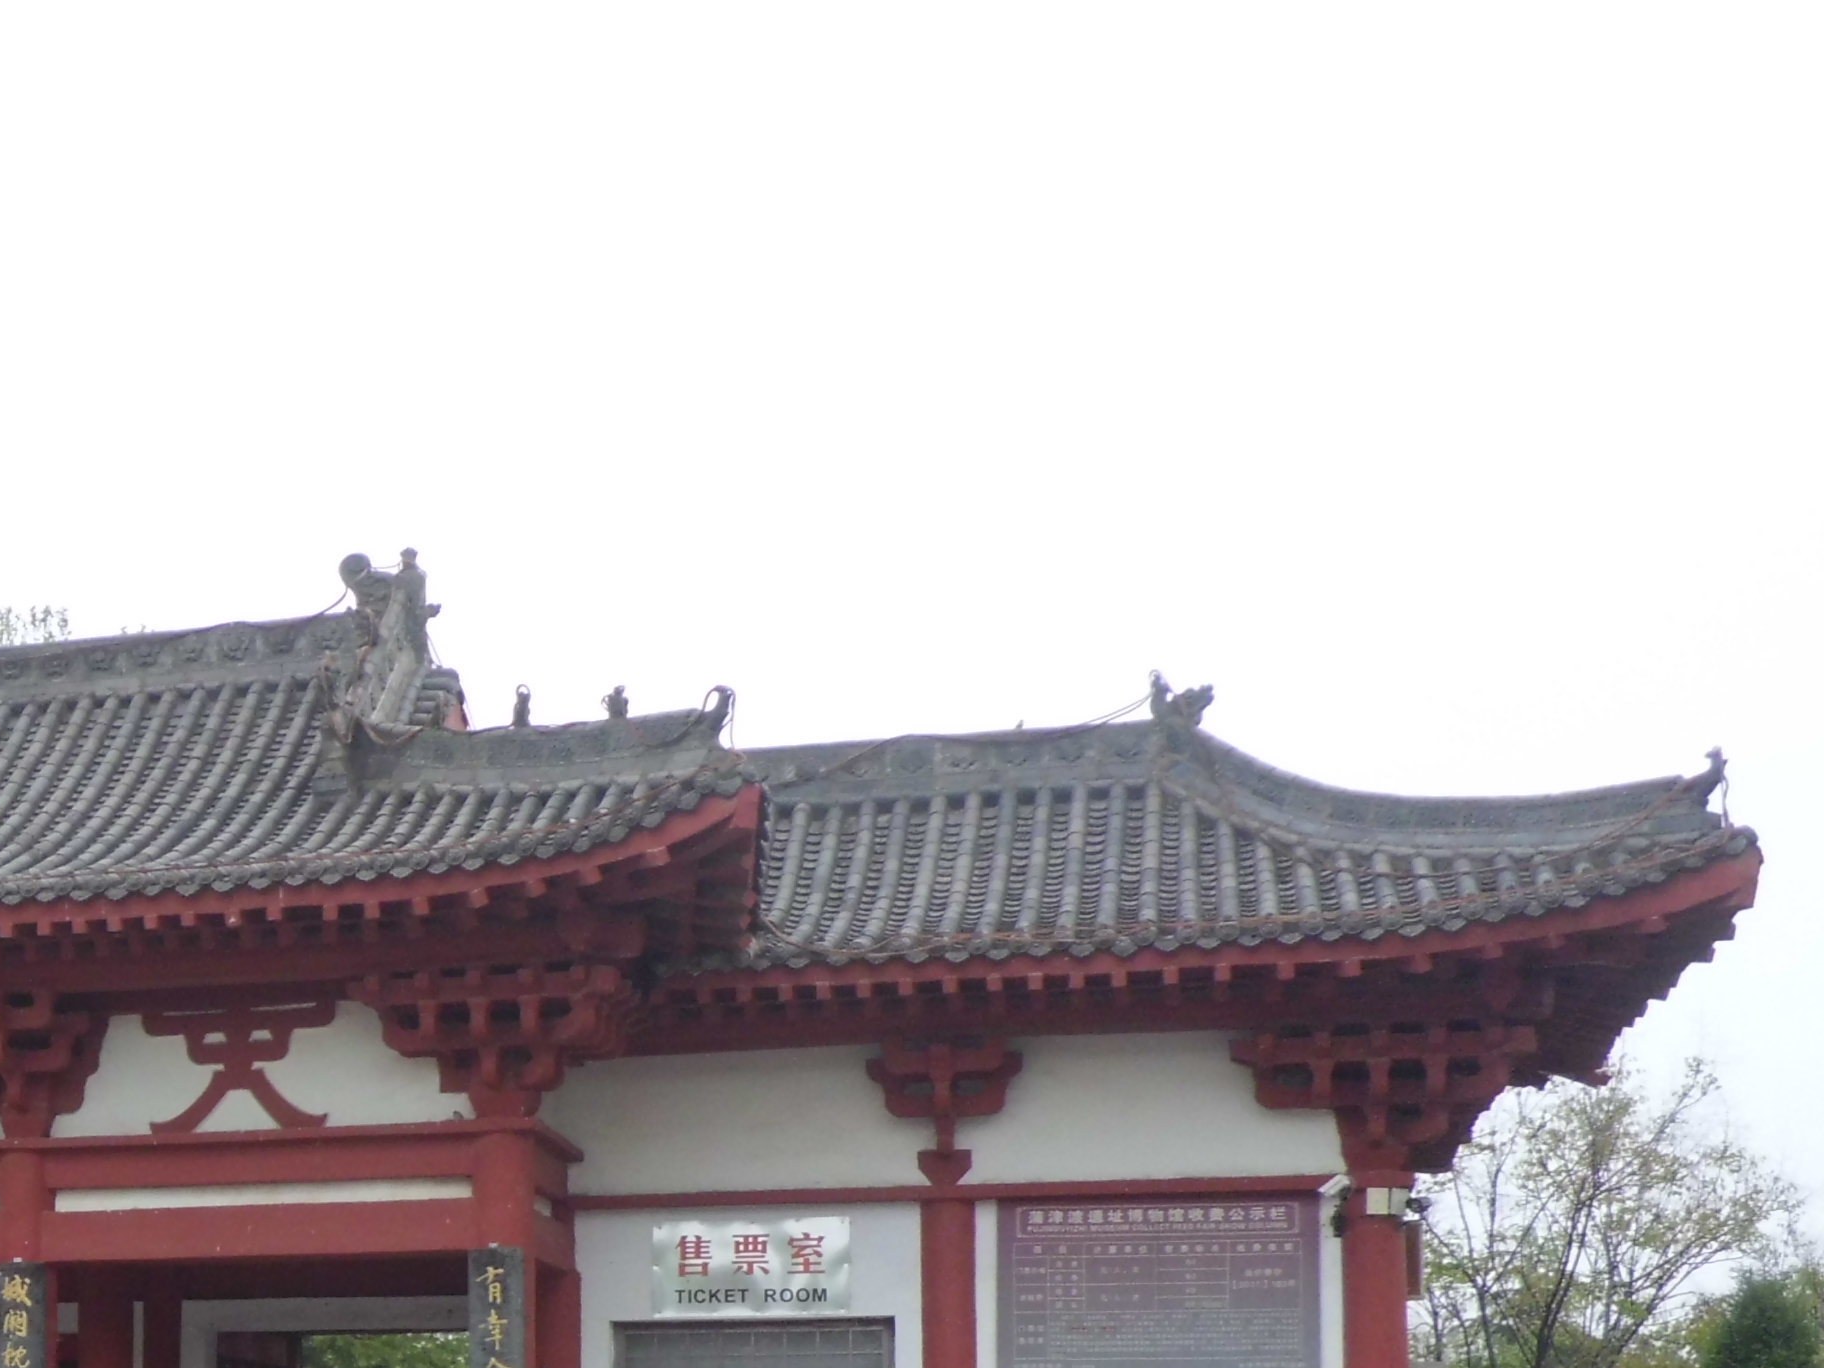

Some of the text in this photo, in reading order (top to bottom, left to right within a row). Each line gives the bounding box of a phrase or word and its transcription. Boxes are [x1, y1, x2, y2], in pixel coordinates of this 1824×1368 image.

[674, 1231, 827, 1278] 售票室
[674, 1287, 828, 1304] TICKET ROOM
